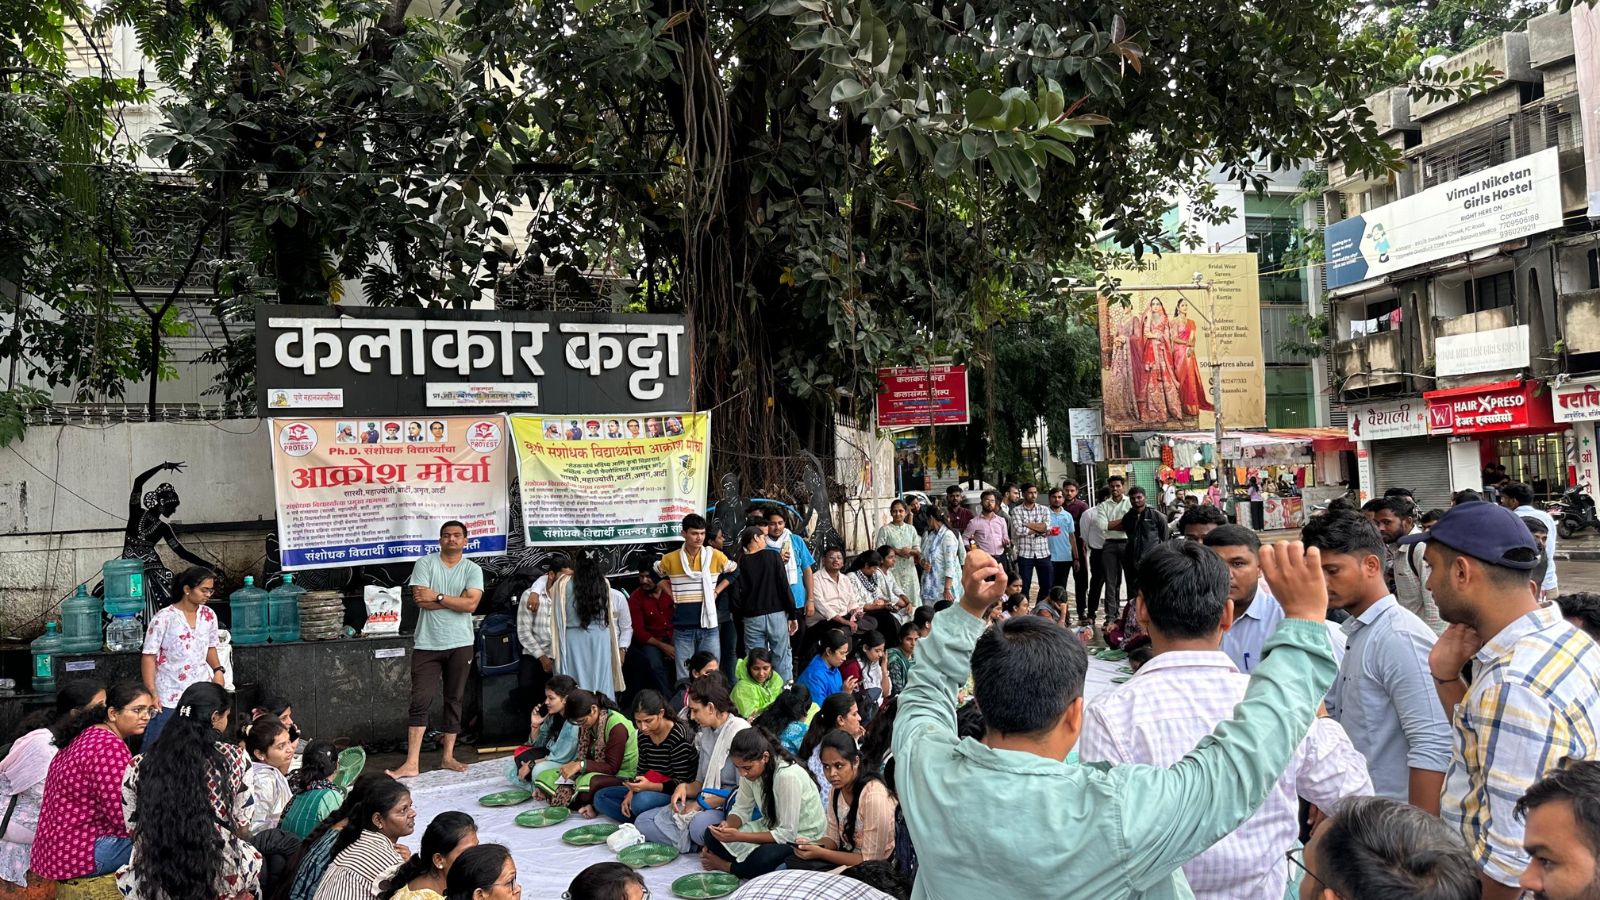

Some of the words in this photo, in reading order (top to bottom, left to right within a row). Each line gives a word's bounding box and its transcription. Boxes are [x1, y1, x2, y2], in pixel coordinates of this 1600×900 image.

[1446, 182, 1480, 202] Vimal
[1482, 168, 1532, 190] Niketan
[1463, 195, 1491, 210] Girls
[1492, 180, 1533, 202] Hostel
[1478, 208, 1492, 217] HERE
[1493, 205, 1503, 213] ON
[1500, 208, 1529, 221] Contact
[268, 317, 550, 376] कलाकार
[559, 322, 685, 400] कट्टा
[1453, 400, 1478, 413] HAIR
[1477, 394, 1525, 413] XPRESO
[1367, 403, 1410, 426] वैशाली
[1455, 414, 1474, 427] हेअर
[284, 444, 313, 452] PROTEST
[329, 447, 361, 455] Ph.D.
[364, 445, 403, 455] संशोधक
[546, 442, 588, 460] संशोधक
[649, 438, 683, 454] आक्रोश
[290, 457, 408, 489] आक्रोश
[415, 456, 491, 484] मोर्चा
[543, 527, 580, 538] संशोधक
[583, 526, 615, 538] विद्यार्थी
[617, 526, 648, 537] समन्वय
[650, 523, 668, 537] कृती
[304, 549, 346, 561] संशोधक
[349, 544, 385, 558] विद्यार्थी
[388, 544, 421, 555] समन्वय
